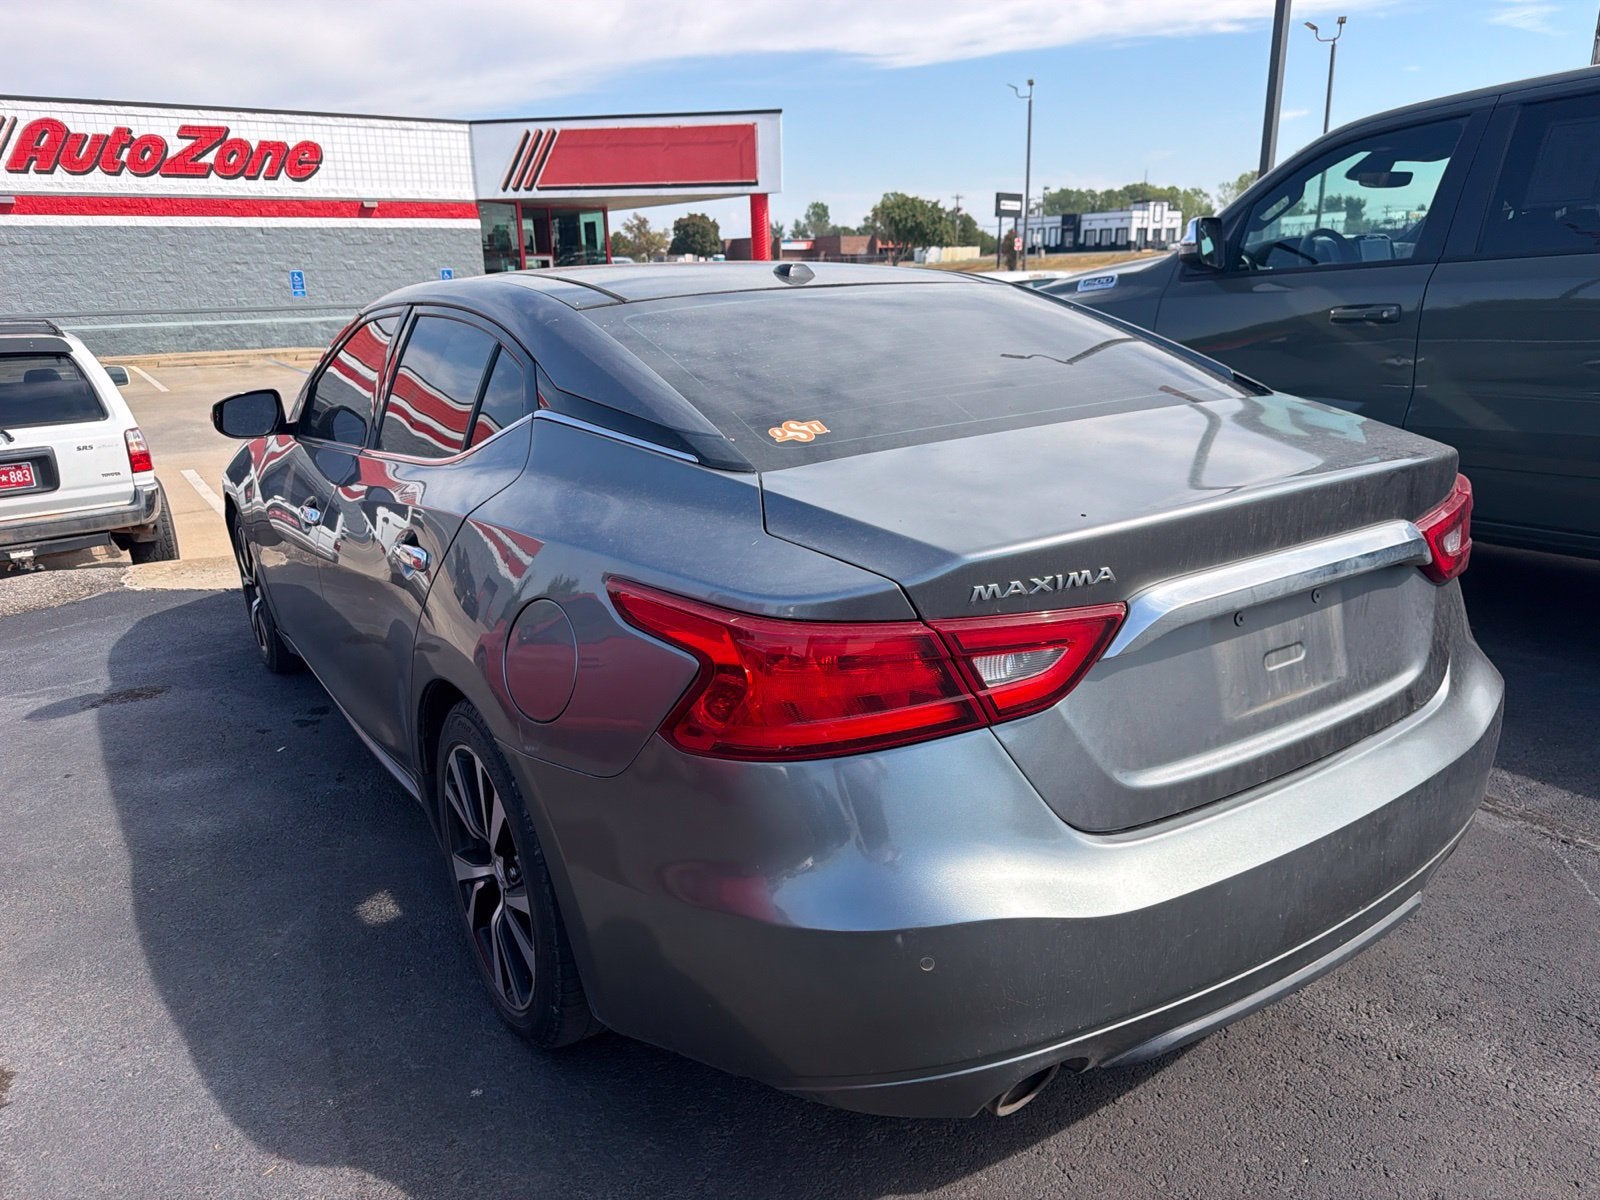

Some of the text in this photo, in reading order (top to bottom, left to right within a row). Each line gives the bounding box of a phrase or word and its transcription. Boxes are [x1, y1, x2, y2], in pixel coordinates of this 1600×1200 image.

[5, 117, 323, 182] AutoZone
[9, 469, 31, 483] 883
[970, 566, 1117, 602] MAXIMA
